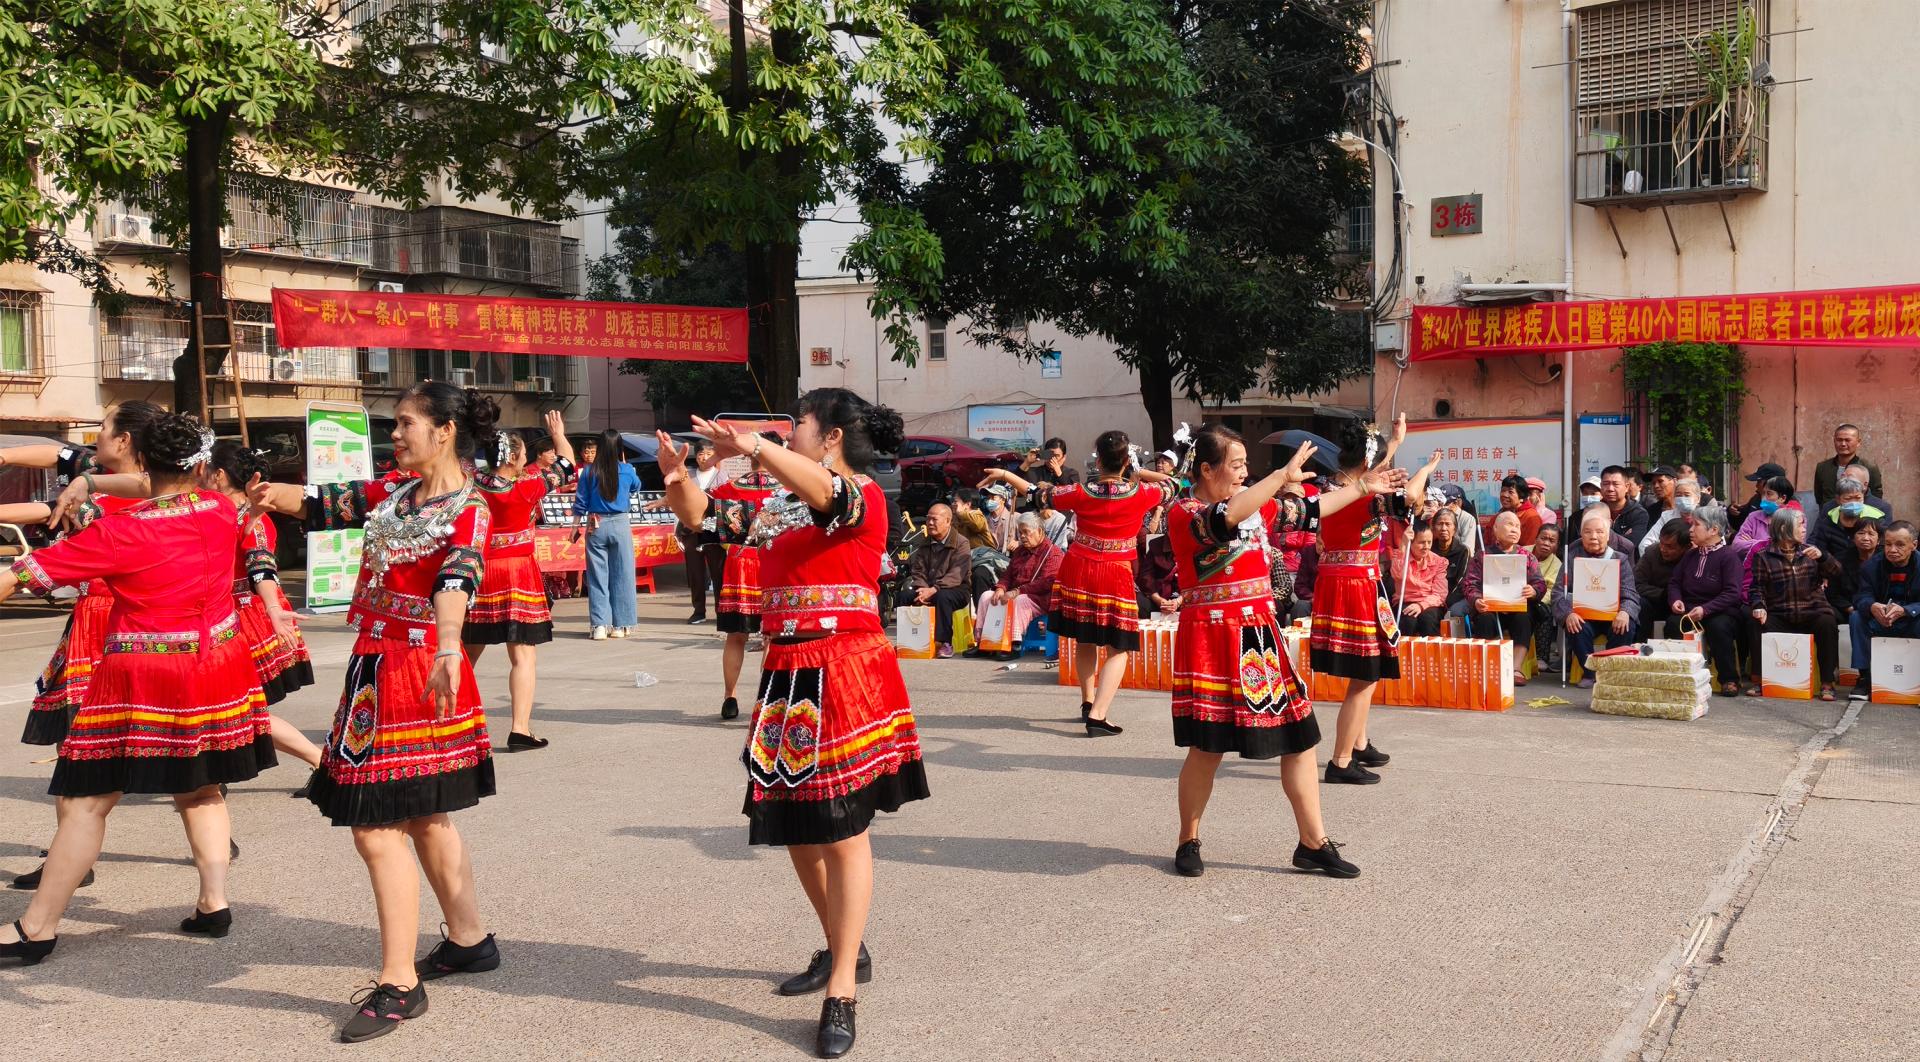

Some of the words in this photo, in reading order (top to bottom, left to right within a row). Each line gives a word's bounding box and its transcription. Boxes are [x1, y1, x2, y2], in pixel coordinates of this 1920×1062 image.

[1435, 202, 1476, 228] 3栋
[1421, 292, 1920, 351] 第34个世界残疾人日暨第40个国际志愿者日敬老助残
[1433, 446, 1519, 460] 共同团结奋斗
[1433, 468, 1519, 482] 共同繁荣发展
